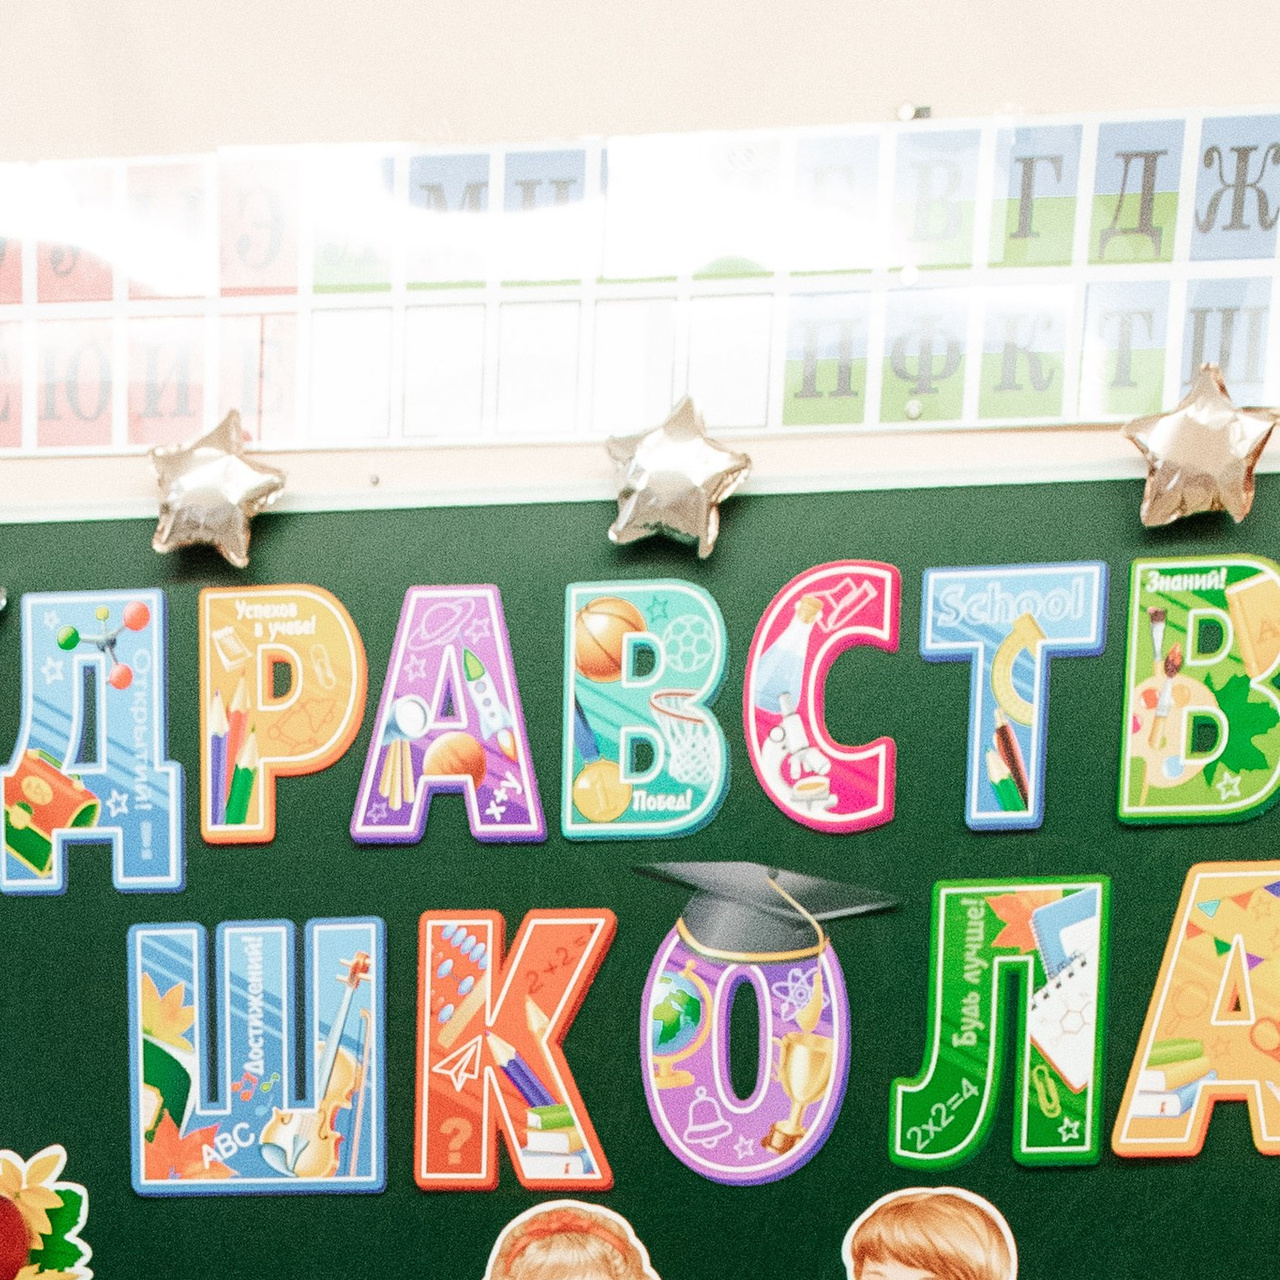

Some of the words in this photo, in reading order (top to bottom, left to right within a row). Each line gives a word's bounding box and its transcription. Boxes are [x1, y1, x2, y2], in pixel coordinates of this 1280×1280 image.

[1007, 154, 1064, 241] Г
[1097, 148, 1170, 262] Д
[1193, 143, 1280, 236] Ж
[37, 340, 113, 423] Ю
[137, 342, 197, 419] И
[792, 316, 862, 400] П
[888, 313, 964, 397] Ф
[992, 312, 1056, 394] К
[937, 575, 1085, 627] School
[1145, 566, 1228, 594] Знаний!
[960, 897, 989, 985] лучше!
[240, 934, 265, 1077] Достижений!
[951, 990, 986, 1048] Будь
[201, 1121, 256, 1170] ABC
